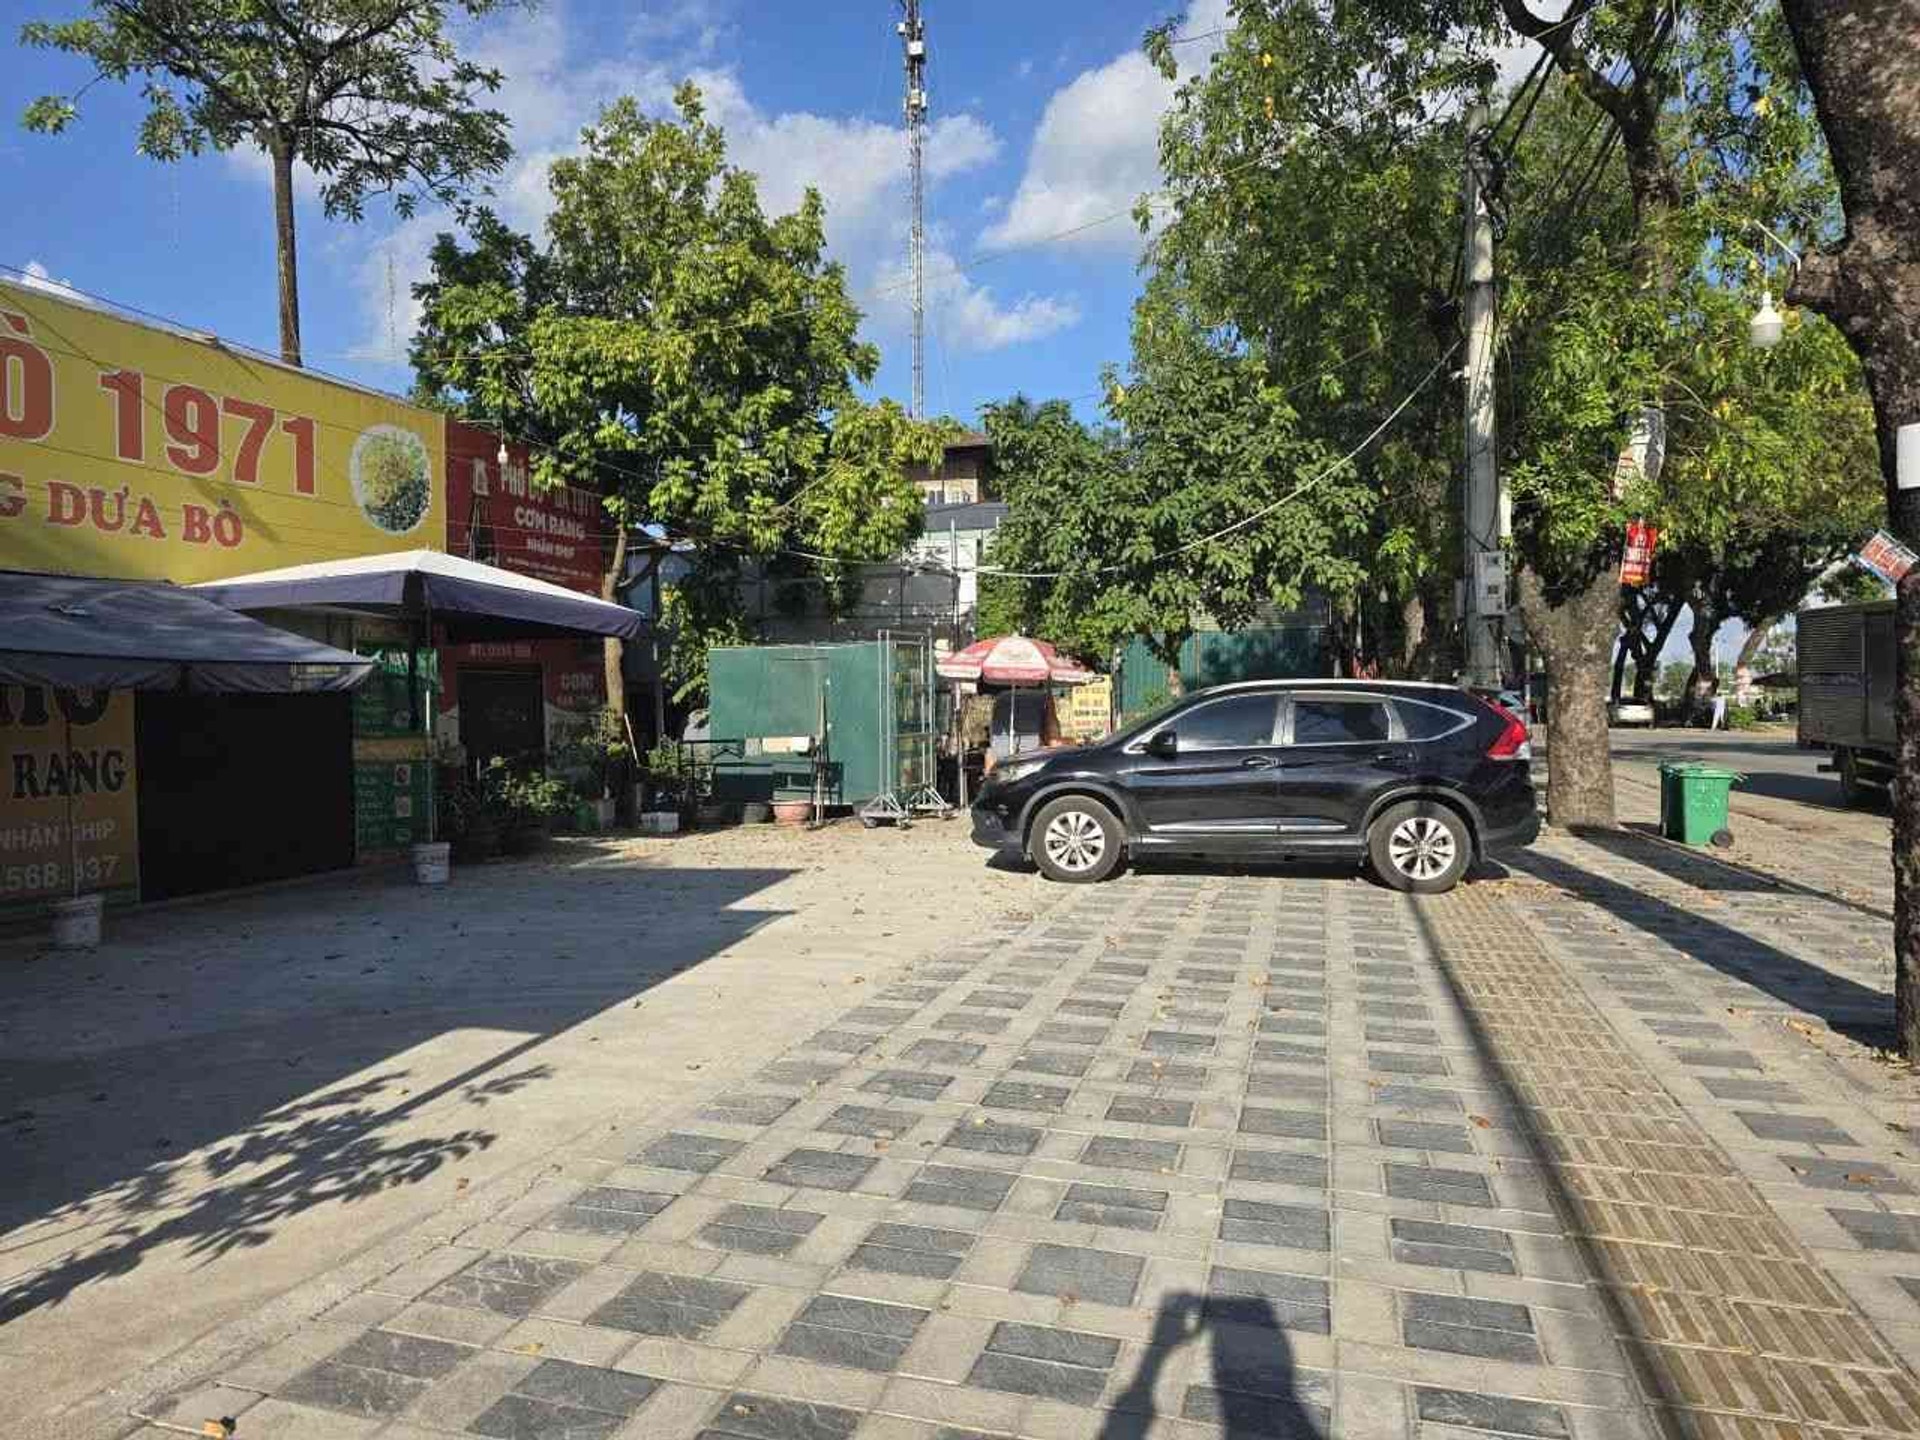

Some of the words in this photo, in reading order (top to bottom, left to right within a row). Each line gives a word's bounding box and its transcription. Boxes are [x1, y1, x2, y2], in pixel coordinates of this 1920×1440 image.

[97, 370, 317, 496] 1971
[45, 479, 168, 540] DƯA
[180, 497, 244, 549] BÒ
[11, 749, 127, 799] RANG
